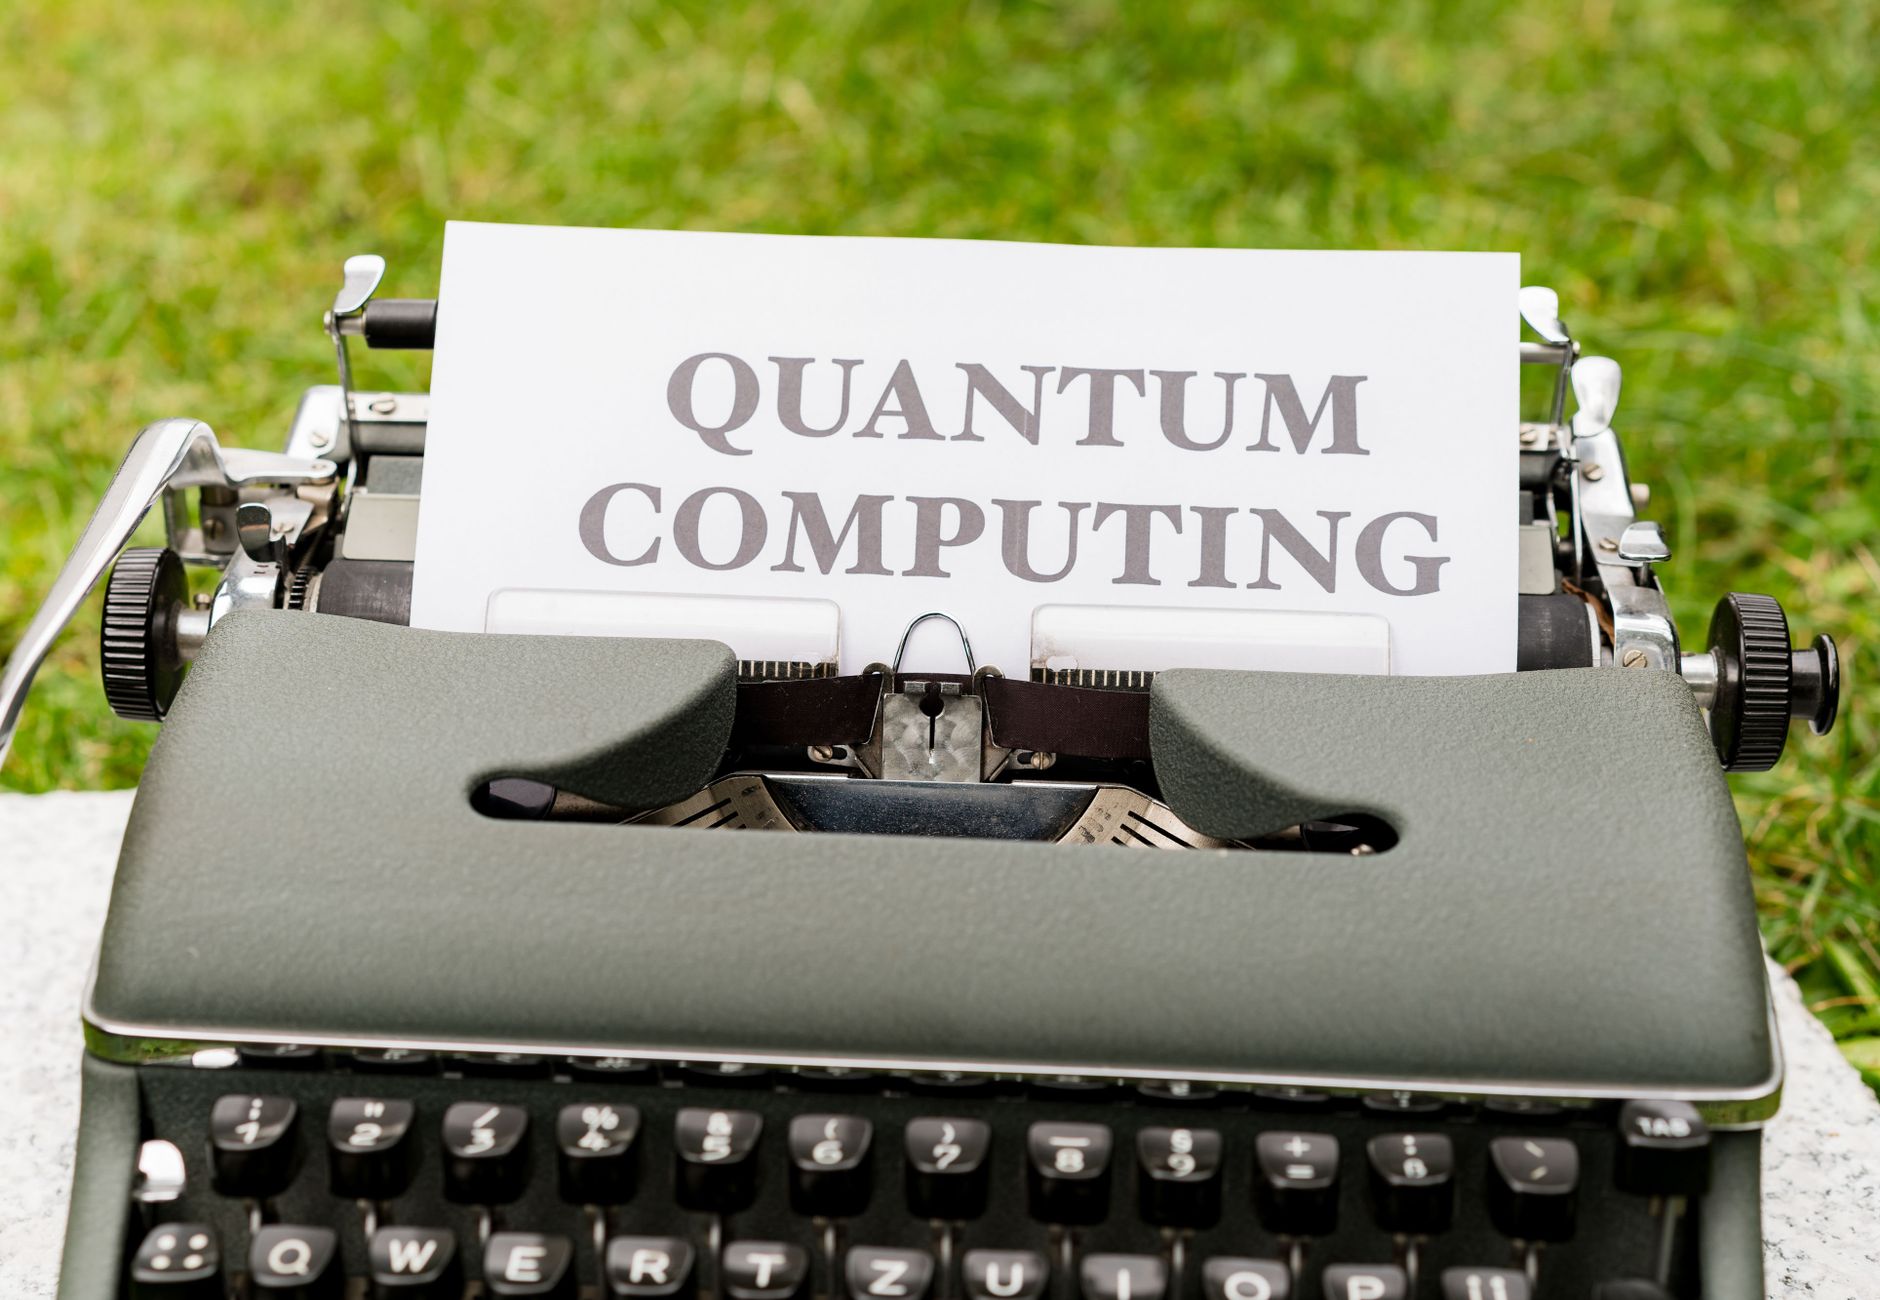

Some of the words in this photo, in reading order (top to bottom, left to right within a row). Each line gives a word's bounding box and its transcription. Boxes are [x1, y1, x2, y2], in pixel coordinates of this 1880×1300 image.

[667, 352, 1370, 456] QUANTUM
[578, 482, 1451, 597] COMPUTING
[234, 1120, 260, 1145] 1
[349, 1123, 383, 1146] 2
[1635, 1115, 1692, 1138] TAB
[464, 1128, 496, 1154] 3
[577, 1129, 610, 1151] 4
[702, 1134, 732, 1160] 5
[813, 1140, 843, 1165] 6
[933, 1144, 961, 1170] 7
[1055, 1148, 1085, 1173] 8
[1167, 1152, 1196, 1177] 9
[268, 1239, 311, 1275] Q
[388, 1239, 437, 1273] W
[505, 1246, 546, 1282] E
[629, 1249, 670, 1284] R
[747, 1253, 785, 1288] T
[868, 1259, 908, 1295] Z
[985, 1261, 1025, 1297] U
[1224, 1271, 1271, 1300] O
[1346, 1275, 1386, 1300] P
